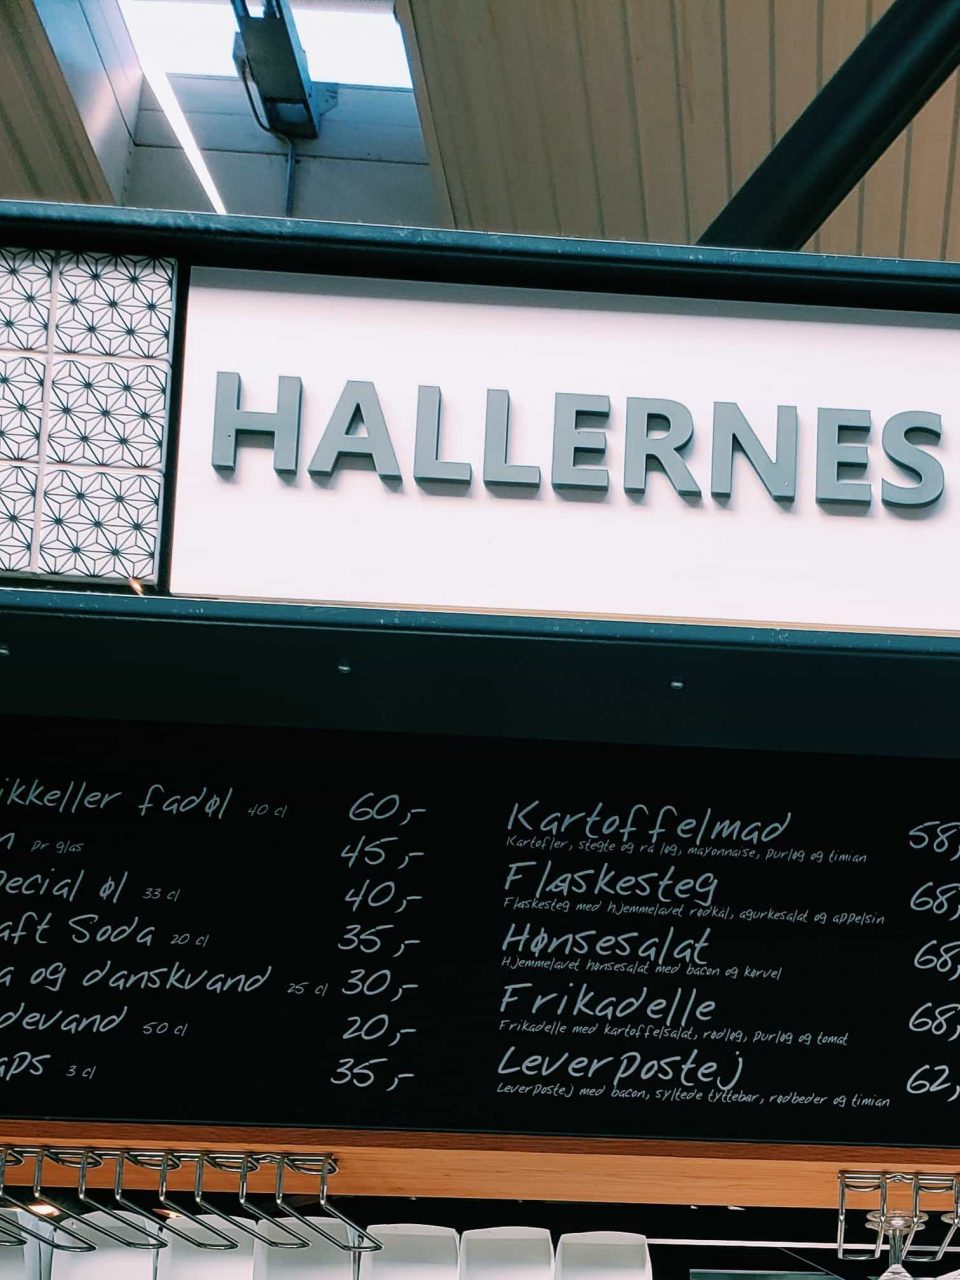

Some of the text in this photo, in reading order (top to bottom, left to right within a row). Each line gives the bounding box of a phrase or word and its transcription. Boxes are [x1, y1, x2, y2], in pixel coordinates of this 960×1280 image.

[212, 371, 946, 508] HALLERNES
[138, 785, 233, 819] fadøl
[248, 804, 269, 818] 40
[349, 793, 427, 826] 60,-
[507, 800, 791, 846] Kartoffelmad
[56, 836, 425, 869] glas 45,-
[579, 840, 616, 853] stegte
[687, 845, 760, 860] mayonnaise,
[765, 848, 805, 862] purløg
[829, 850, 867, 863] timian
[99, 871, 128, 904] øl
[143, 888, 161, 899] 33
[345, 880, 422, 913] 40,-
[504, 860, 718, 907] Flæskesteg
[576, 900, 601, 912] med
[607, 903, 684, 917] hjemmelavet
[740, 908, 809, 923] agurkesalat
[832, 912, 885, 926] appelsin
[69, 914, 155, 946] Soda
[170, 933, 190, 945] 20
[338, 925, 420, 957] 35,-
[502, 922, 711, 965] Hønsesalat
[30, 962, 66, 991] og
[82, 960, 271, 993] danskvand
[287, 981, 309, 995] 25
[342, 969, 418, 1001] 30,-
[501, 956, 580, 971] Hjemmelavet
[586, 960, 651, 975] hønsesalat
[655, 965, 680, 975] med
[686, 964, 720, 977] bacon
[500, 982, 716, 1027] Frikadelle
[143, 1022, 168, 1034] 50
[343, 1014, 416, 1046] 20,-
[499, 1019, 566, 1035] Frikadelle
[572, 1022, 598, 1034] med
[604, 1024, 698, 1041] kartoffelsalat,
[753, 1030, 793, 1045] purløg
[817, 1031, 848, 1046] tomat
[331, 1058, 415, 1091] 35,-
[497, 1045, 743, 1090] Leverpostej
[497, 1082, 574, 1098] Leverpostej
[579, 1085, 606, 1097] med
[611, 1085, 650, 1100] bacon,
[655, 1086, 703, 1101] syltede
[769, 1089, 828, 1105] rødbeder
[852, 1092, 891, 1108] timian
